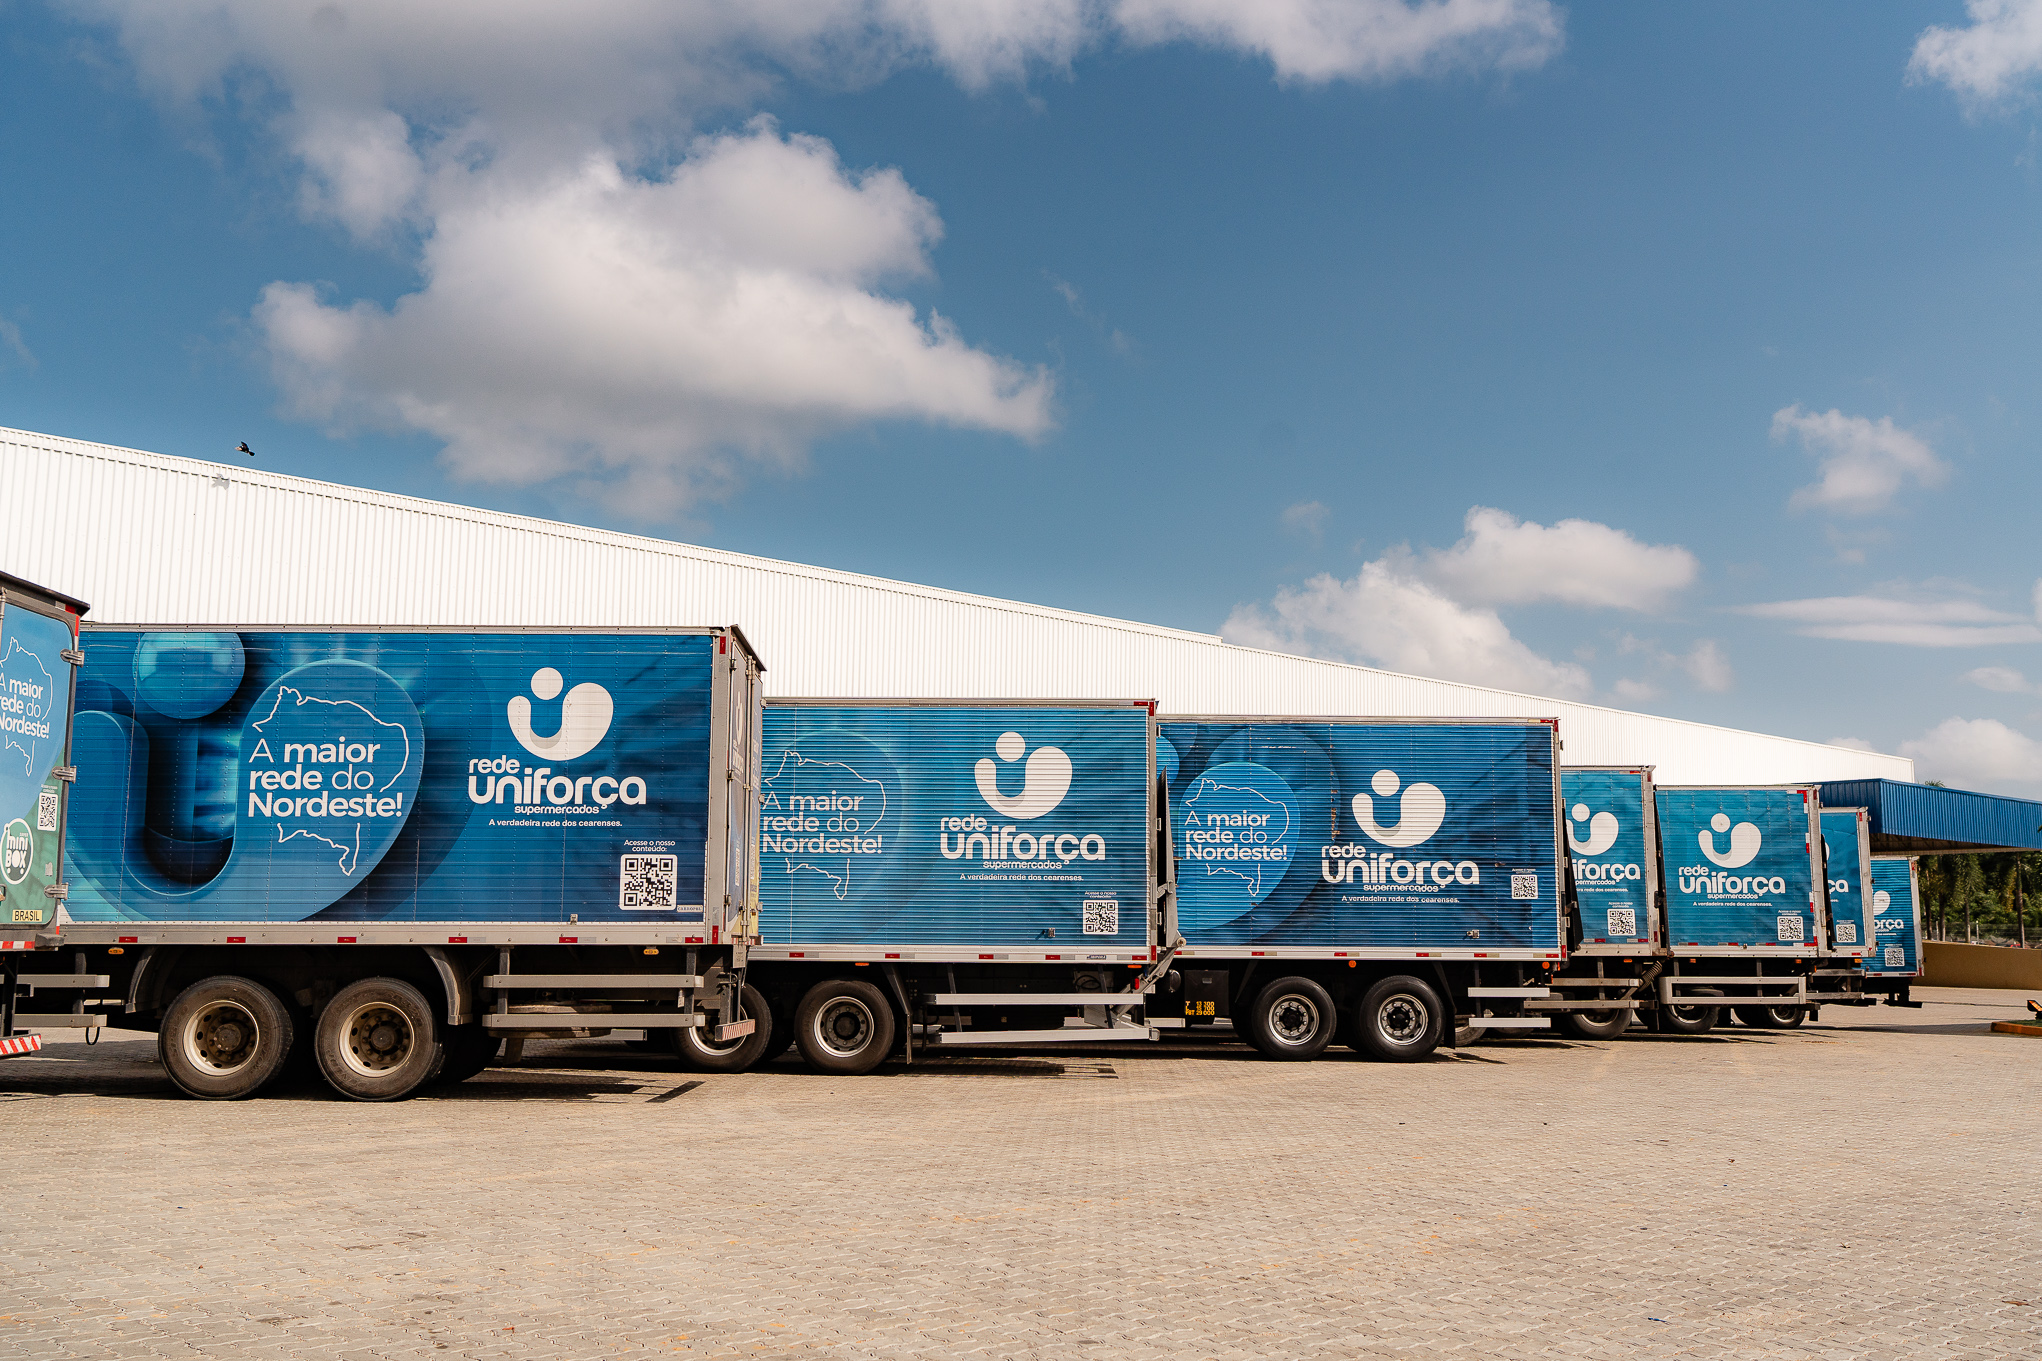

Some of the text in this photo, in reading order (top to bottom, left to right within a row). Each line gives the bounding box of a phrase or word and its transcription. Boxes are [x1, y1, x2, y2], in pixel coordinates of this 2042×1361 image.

[9, 678, 44, 700] maior
[26, 698, 42, 718] do
[248, 736, 381, 763] A maior
[469, 755, 520, 774] rede
[249, 764, 375, 790] rede do
[468, 767, 647, 809] uniforça
[248, 790, 403, 818] Nordeste!
[514, 804, 600, 815] supermercados
[762, 790, 864, 811] A maior
[488, 818, 623, 828] A verdadeira rede dos cearenses.
[763, 812, 860, 832] rede do
[940, 813, 988, 831] rede
[1184, 810, 1271, 826] A maior
[762, 832, 883, 854] Nordeste!
[940, 825, 1106, 865] uniforça
[1185, 827, 1268, 844] rede do
[5, 849, 27, 868] BOX
[1185, 843, 1288, 861] Nordeste!
[1321, 842, 1367, 858] rede
[983, 860, 1063, 870] supermercados
[1321, 853, 1480, 889] uniforça
[1572, 858, 1641, 882] iforça
[1678, 864, 1709, 876] rede
[959, 873, 966, 881] A
[967, 873, 1008, 881] verdadeira
[1679, 871, 1786, 897] uniforça
[1363, 884, 1439, 893] supermercados
[14, 910, 40, 921] BRASIL
